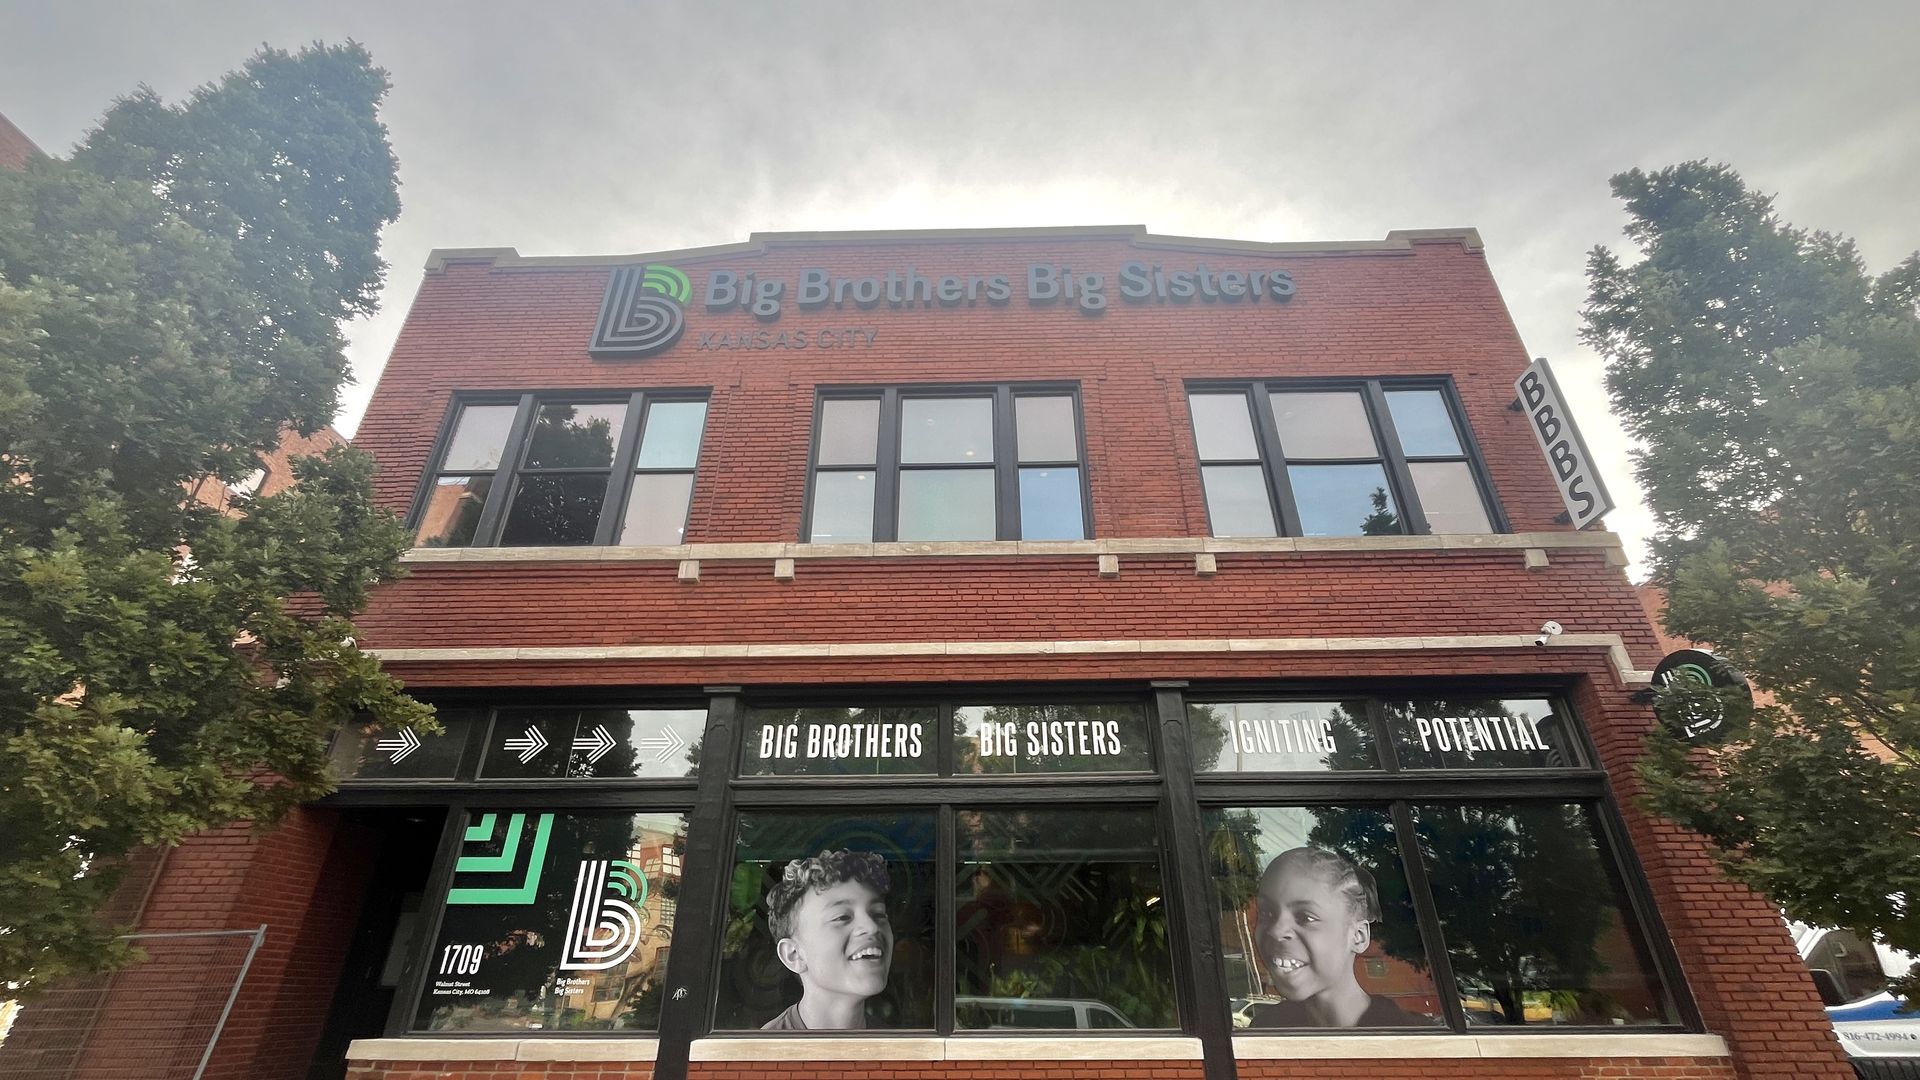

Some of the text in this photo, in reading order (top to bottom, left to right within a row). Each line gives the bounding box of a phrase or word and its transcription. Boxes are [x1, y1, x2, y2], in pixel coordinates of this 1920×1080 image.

[705, 260, 1297, 321] Big Brothers Big Sisters
[700, 327, 879, 350] KANSAS CITY
[1519, 371, 1595, 520] BBBS
[759, 715, 1551, 760] BIG BROTHERS BIG SISTERS IGNITING POTENTIAL
[439, 944, 484, 975] 1709
[554, 987, 565, 996] Big
[556, 977, 590, 987] Big Brothers
